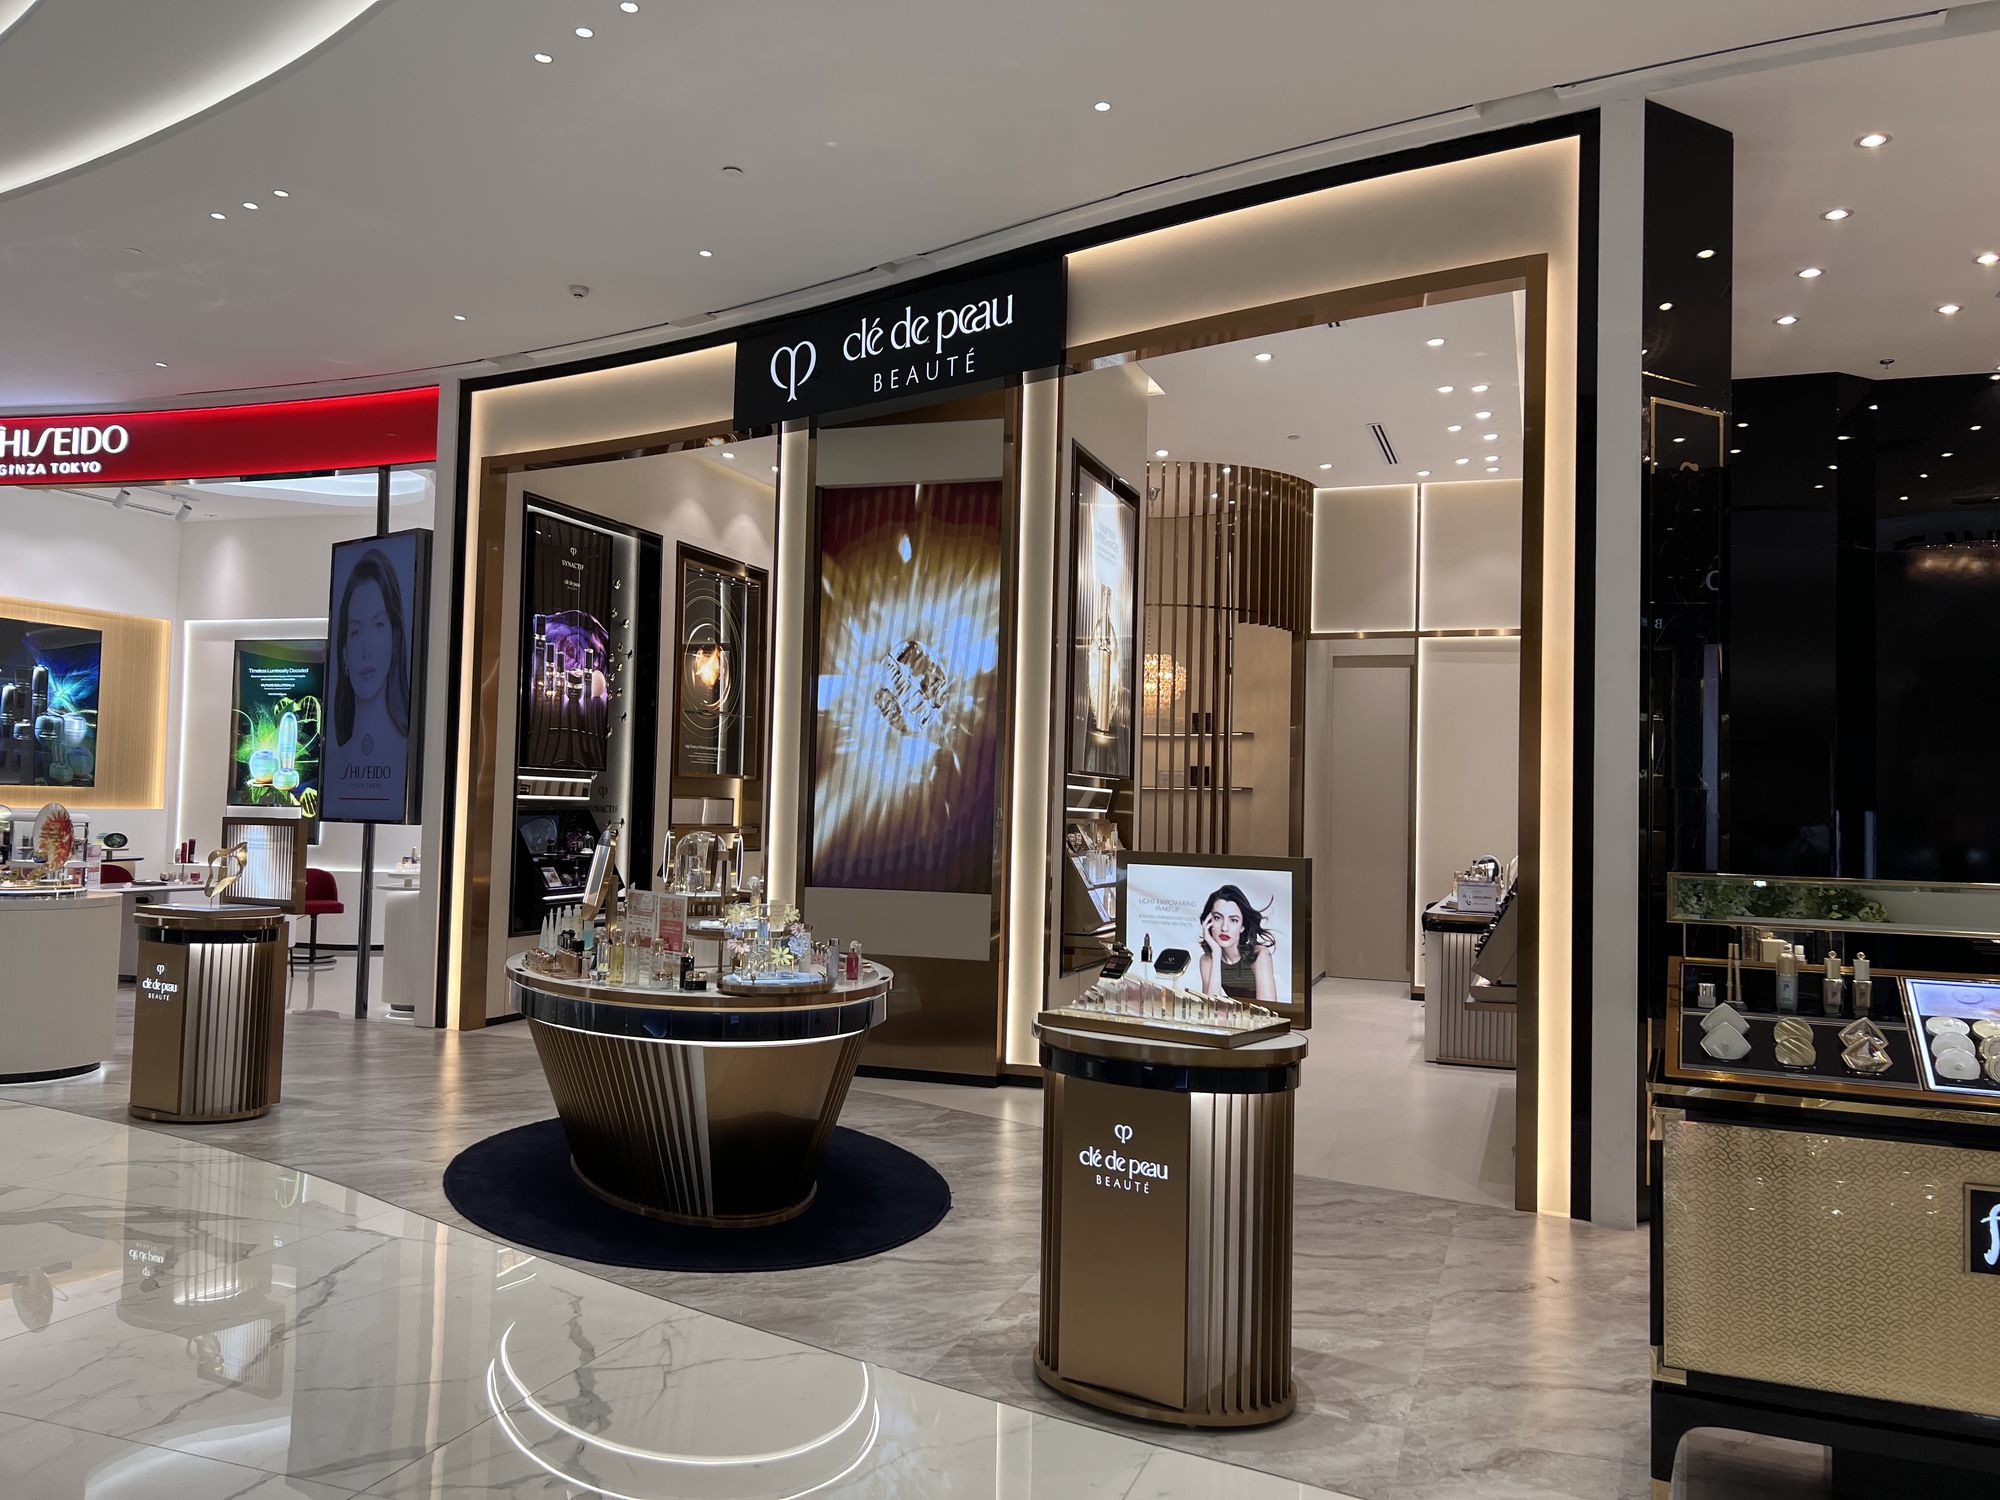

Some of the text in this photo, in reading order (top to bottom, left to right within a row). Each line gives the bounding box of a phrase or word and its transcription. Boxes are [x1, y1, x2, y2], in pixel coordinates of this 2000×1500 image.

[842, 293, 1014, 362] clé de peau
[873, 347, 976, 393] BEAUTÉ
[0, 425, 129, 457] HISEIDO
[50, 461, 102, 475] TOKYO
[340, 763, 392, 780] SHISEIDO
[152, 978, 161, 991] de
[1079, 1145, 1169, 1180] clé de peau
[1096, 1174, 1150, 1194] BEAUTÉ
